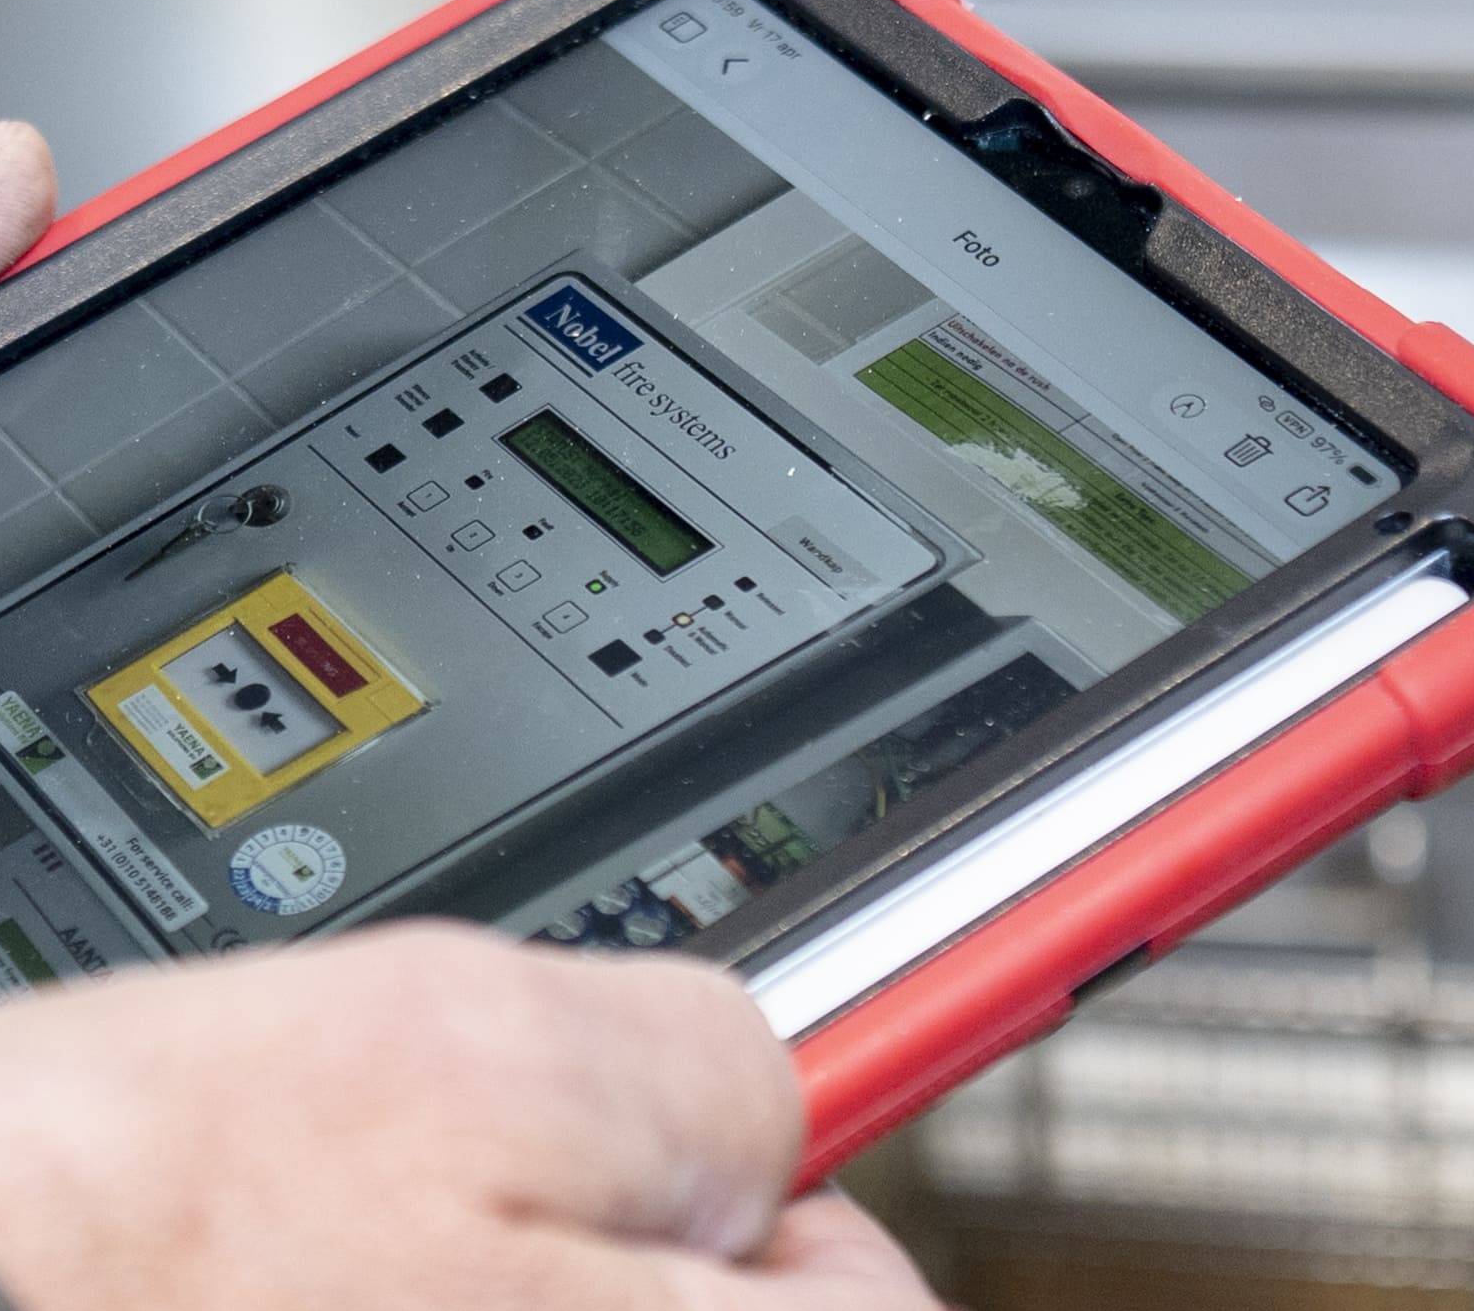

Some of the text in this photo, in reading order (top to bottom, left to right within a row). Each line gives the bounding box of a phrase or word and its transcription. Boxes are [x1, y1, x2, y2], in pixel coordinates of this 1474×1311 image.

[745, 18, 766, 32] Vr
[762, 30, 782, 43] 17
[772, 42, 803, 62] apr
[951, 230, 1003, 268] Foto
[927, 330, 959, 352] Indien
[543, 302, 742, 462] Nobel fire systems
[1281, 414, 1351, 466] VPN 97%
[796, 536, 845, 575] Wandkap
[171, 722, 207, 756] YAENA
[93, 832, 117, 853] +31
[109, 851, 142, 880] (0)10
[123, 836, 197, 912] For service call:
